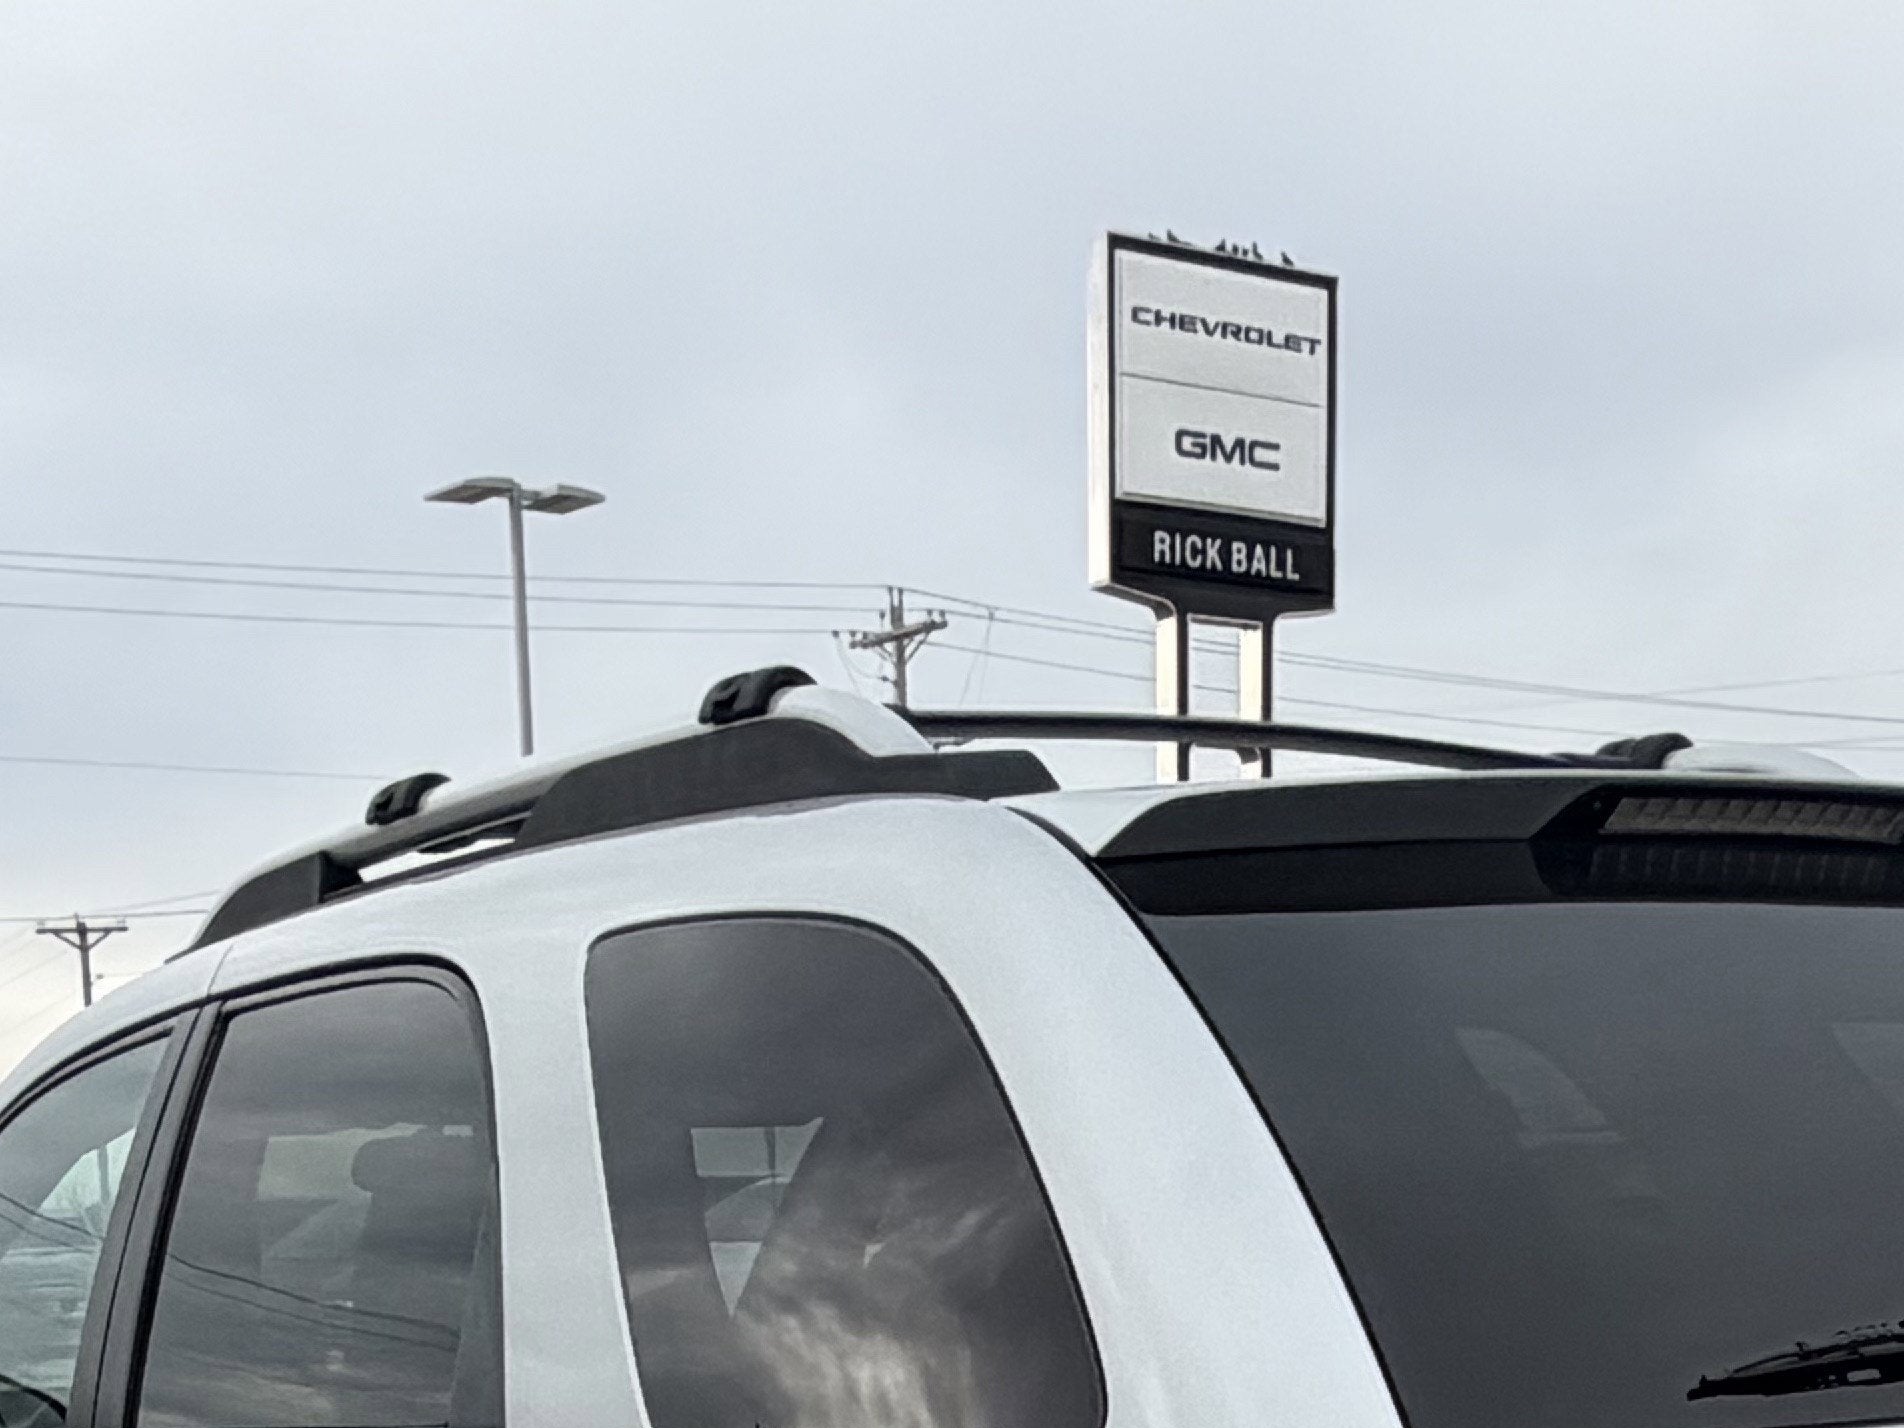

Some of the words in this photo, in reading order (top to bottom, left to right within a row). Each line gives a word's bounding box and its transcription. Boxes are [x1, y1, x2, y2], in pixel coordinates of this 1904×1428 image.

[1131, 306, 1321, 355] CHEVROLET
[1175, 429, 1280, 471] GMC
[1153, 530, 1223, 570] RICK
[1231, 541, 1300, 581] BALL
